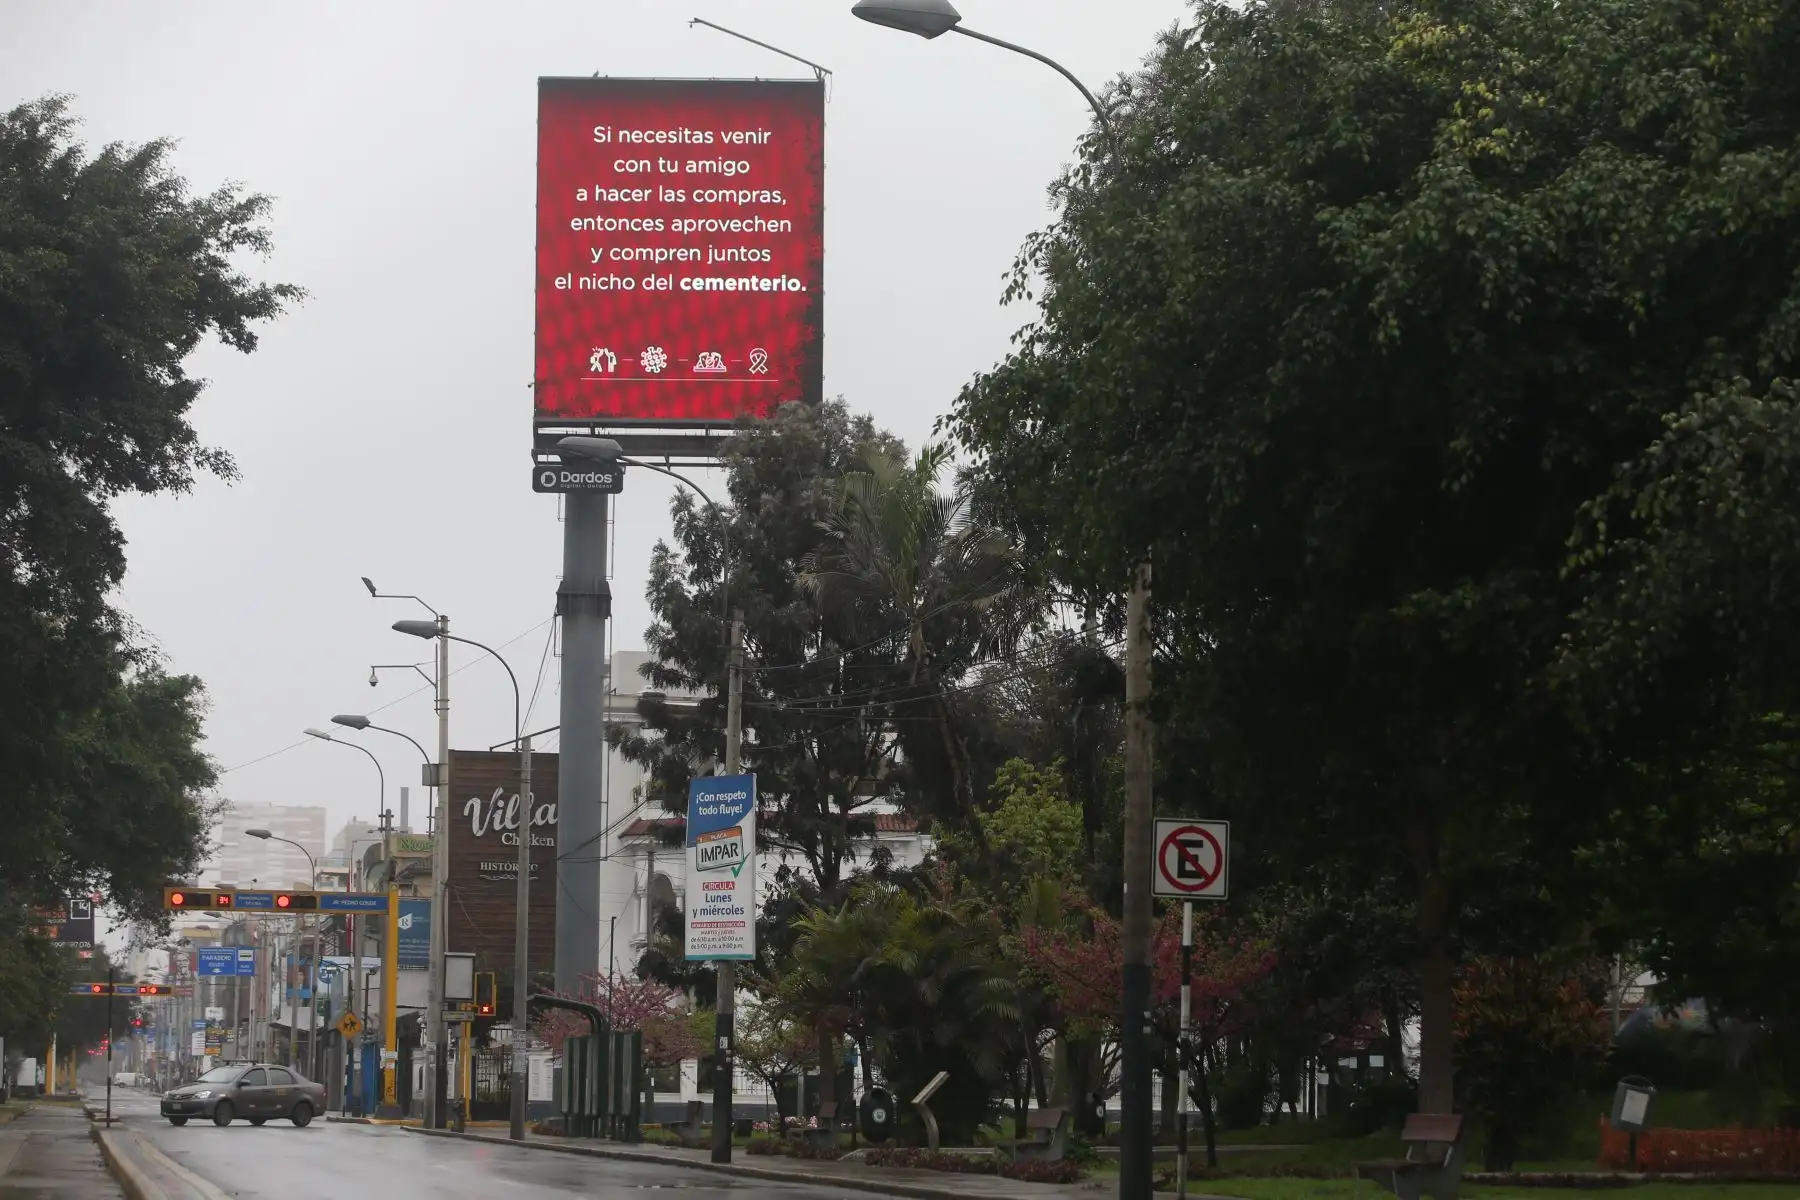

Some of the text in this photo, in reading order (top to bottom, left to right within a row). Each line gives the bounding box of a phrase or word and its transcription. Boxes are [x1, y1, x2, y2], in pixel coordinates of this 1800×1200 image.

[594, 126, 772, 145] Si necesitas venir
[614, 157, 750, 177] con tu amigo
[576, 184, 787, 206] a hacer las compras,
[570, 214, 792, 234] entonces aprovechen
[591, 245, 771, 265] y compren juntos
[554, 272, 807, 292] el nicho del cementerio.
[560, 471, 612, 484] Dardos
[696, 790, 747, 804] ¡Con respeto
[699, 803, 743, 817] todo fluye!
[701, 843, 739, 863] IMPAR
[704, 882, 734, 890] CIRCULA
[705, 893, 732, 903] Lunes
[692, 905, 745, 919] y miércoles
